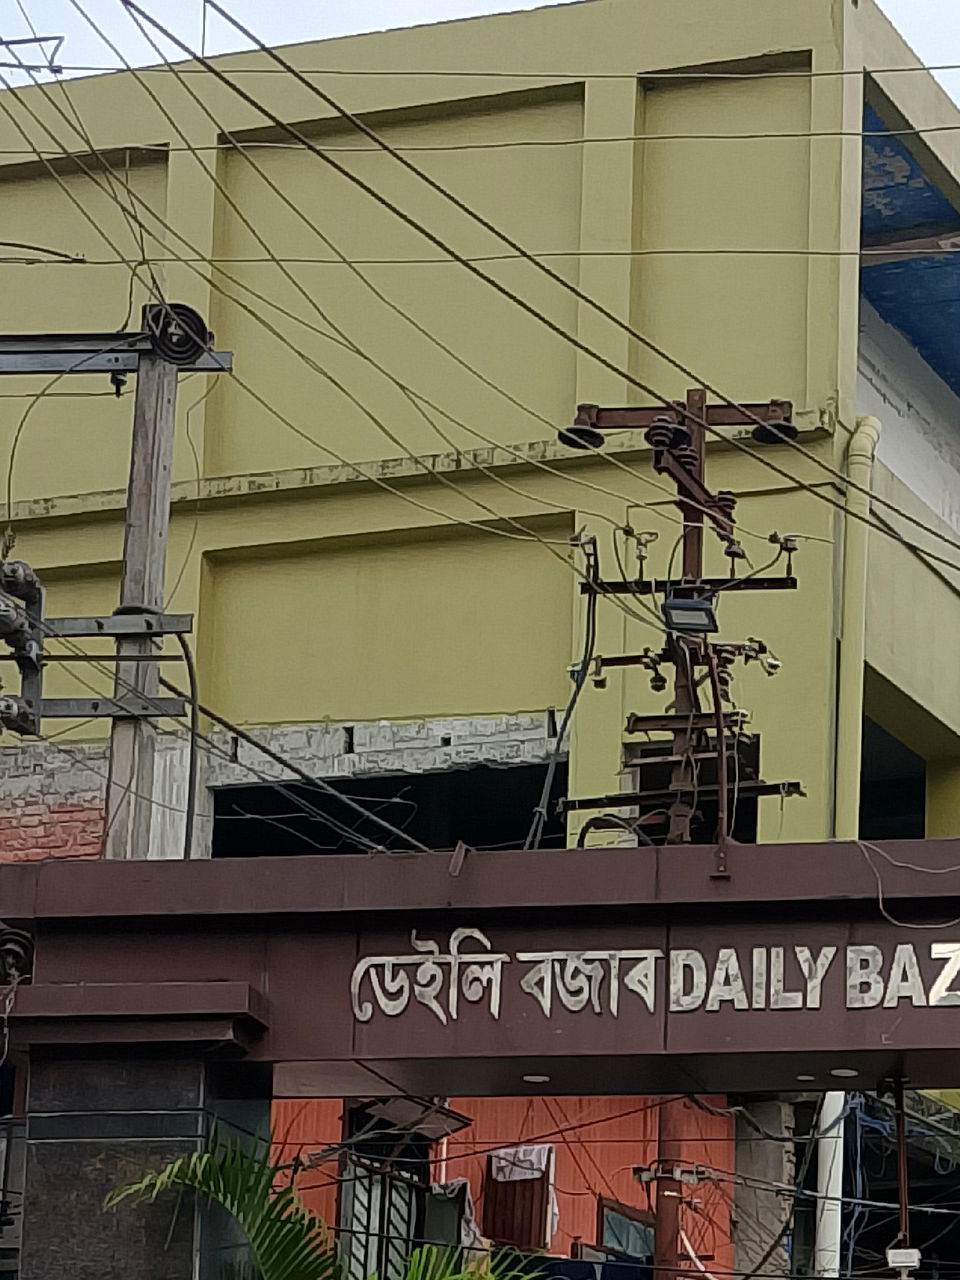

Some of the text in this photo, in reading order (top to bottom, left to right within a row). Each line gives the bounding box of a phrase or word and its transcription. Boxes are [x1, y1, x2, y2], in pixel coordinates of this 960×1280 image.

[351, 927, 665, 1025] ডেইলি বজাৰ
[668, 945, 837, 1013] DAILY
